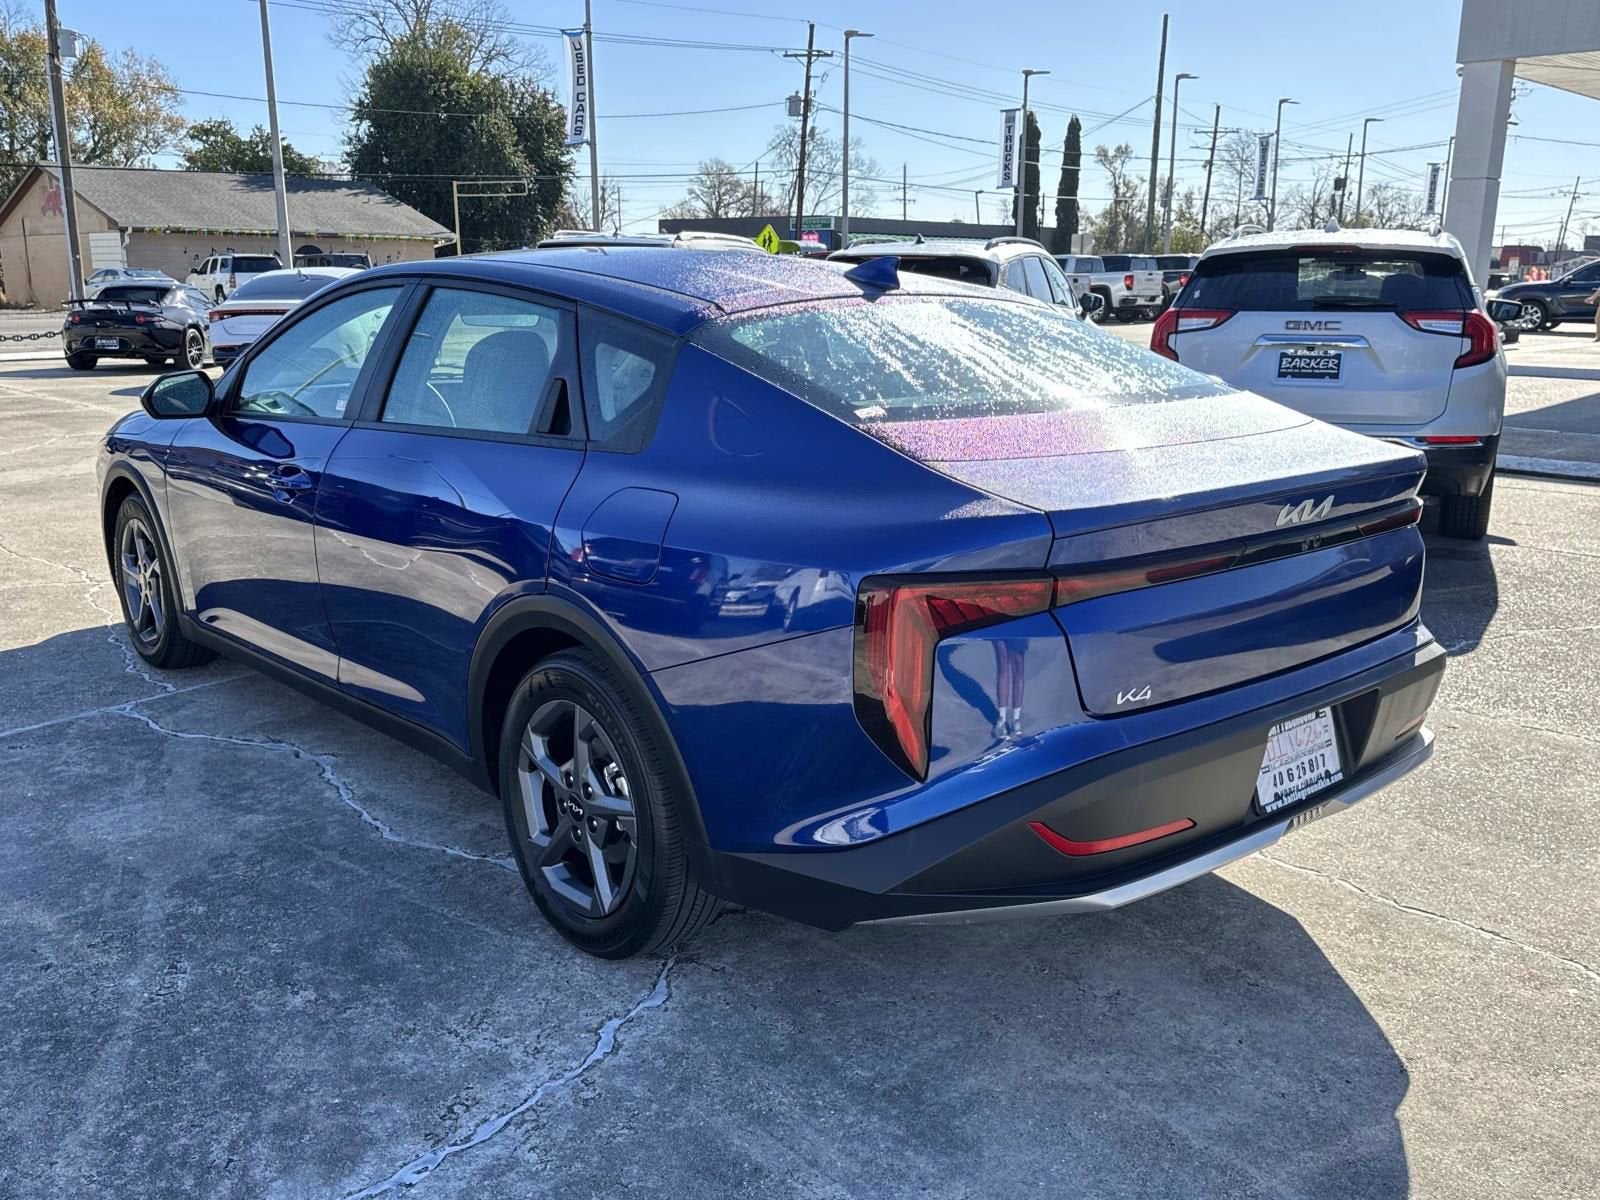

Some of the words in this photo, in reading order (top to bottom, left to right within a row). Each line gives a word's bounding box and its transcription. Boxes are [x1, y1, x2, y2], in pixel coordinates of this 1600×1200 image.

[572, 40, 586, 86] USED
[574, 92, 586, 136] CARS
[1004, 125, 1014, 181] TRUCKS
[1285, 320, 1342, 331] GMC
[1281, 358, 1339, 369] BARKER
[1275, 495, 1336, 526] KIA
[1116, 685, 1152, 705] K4
